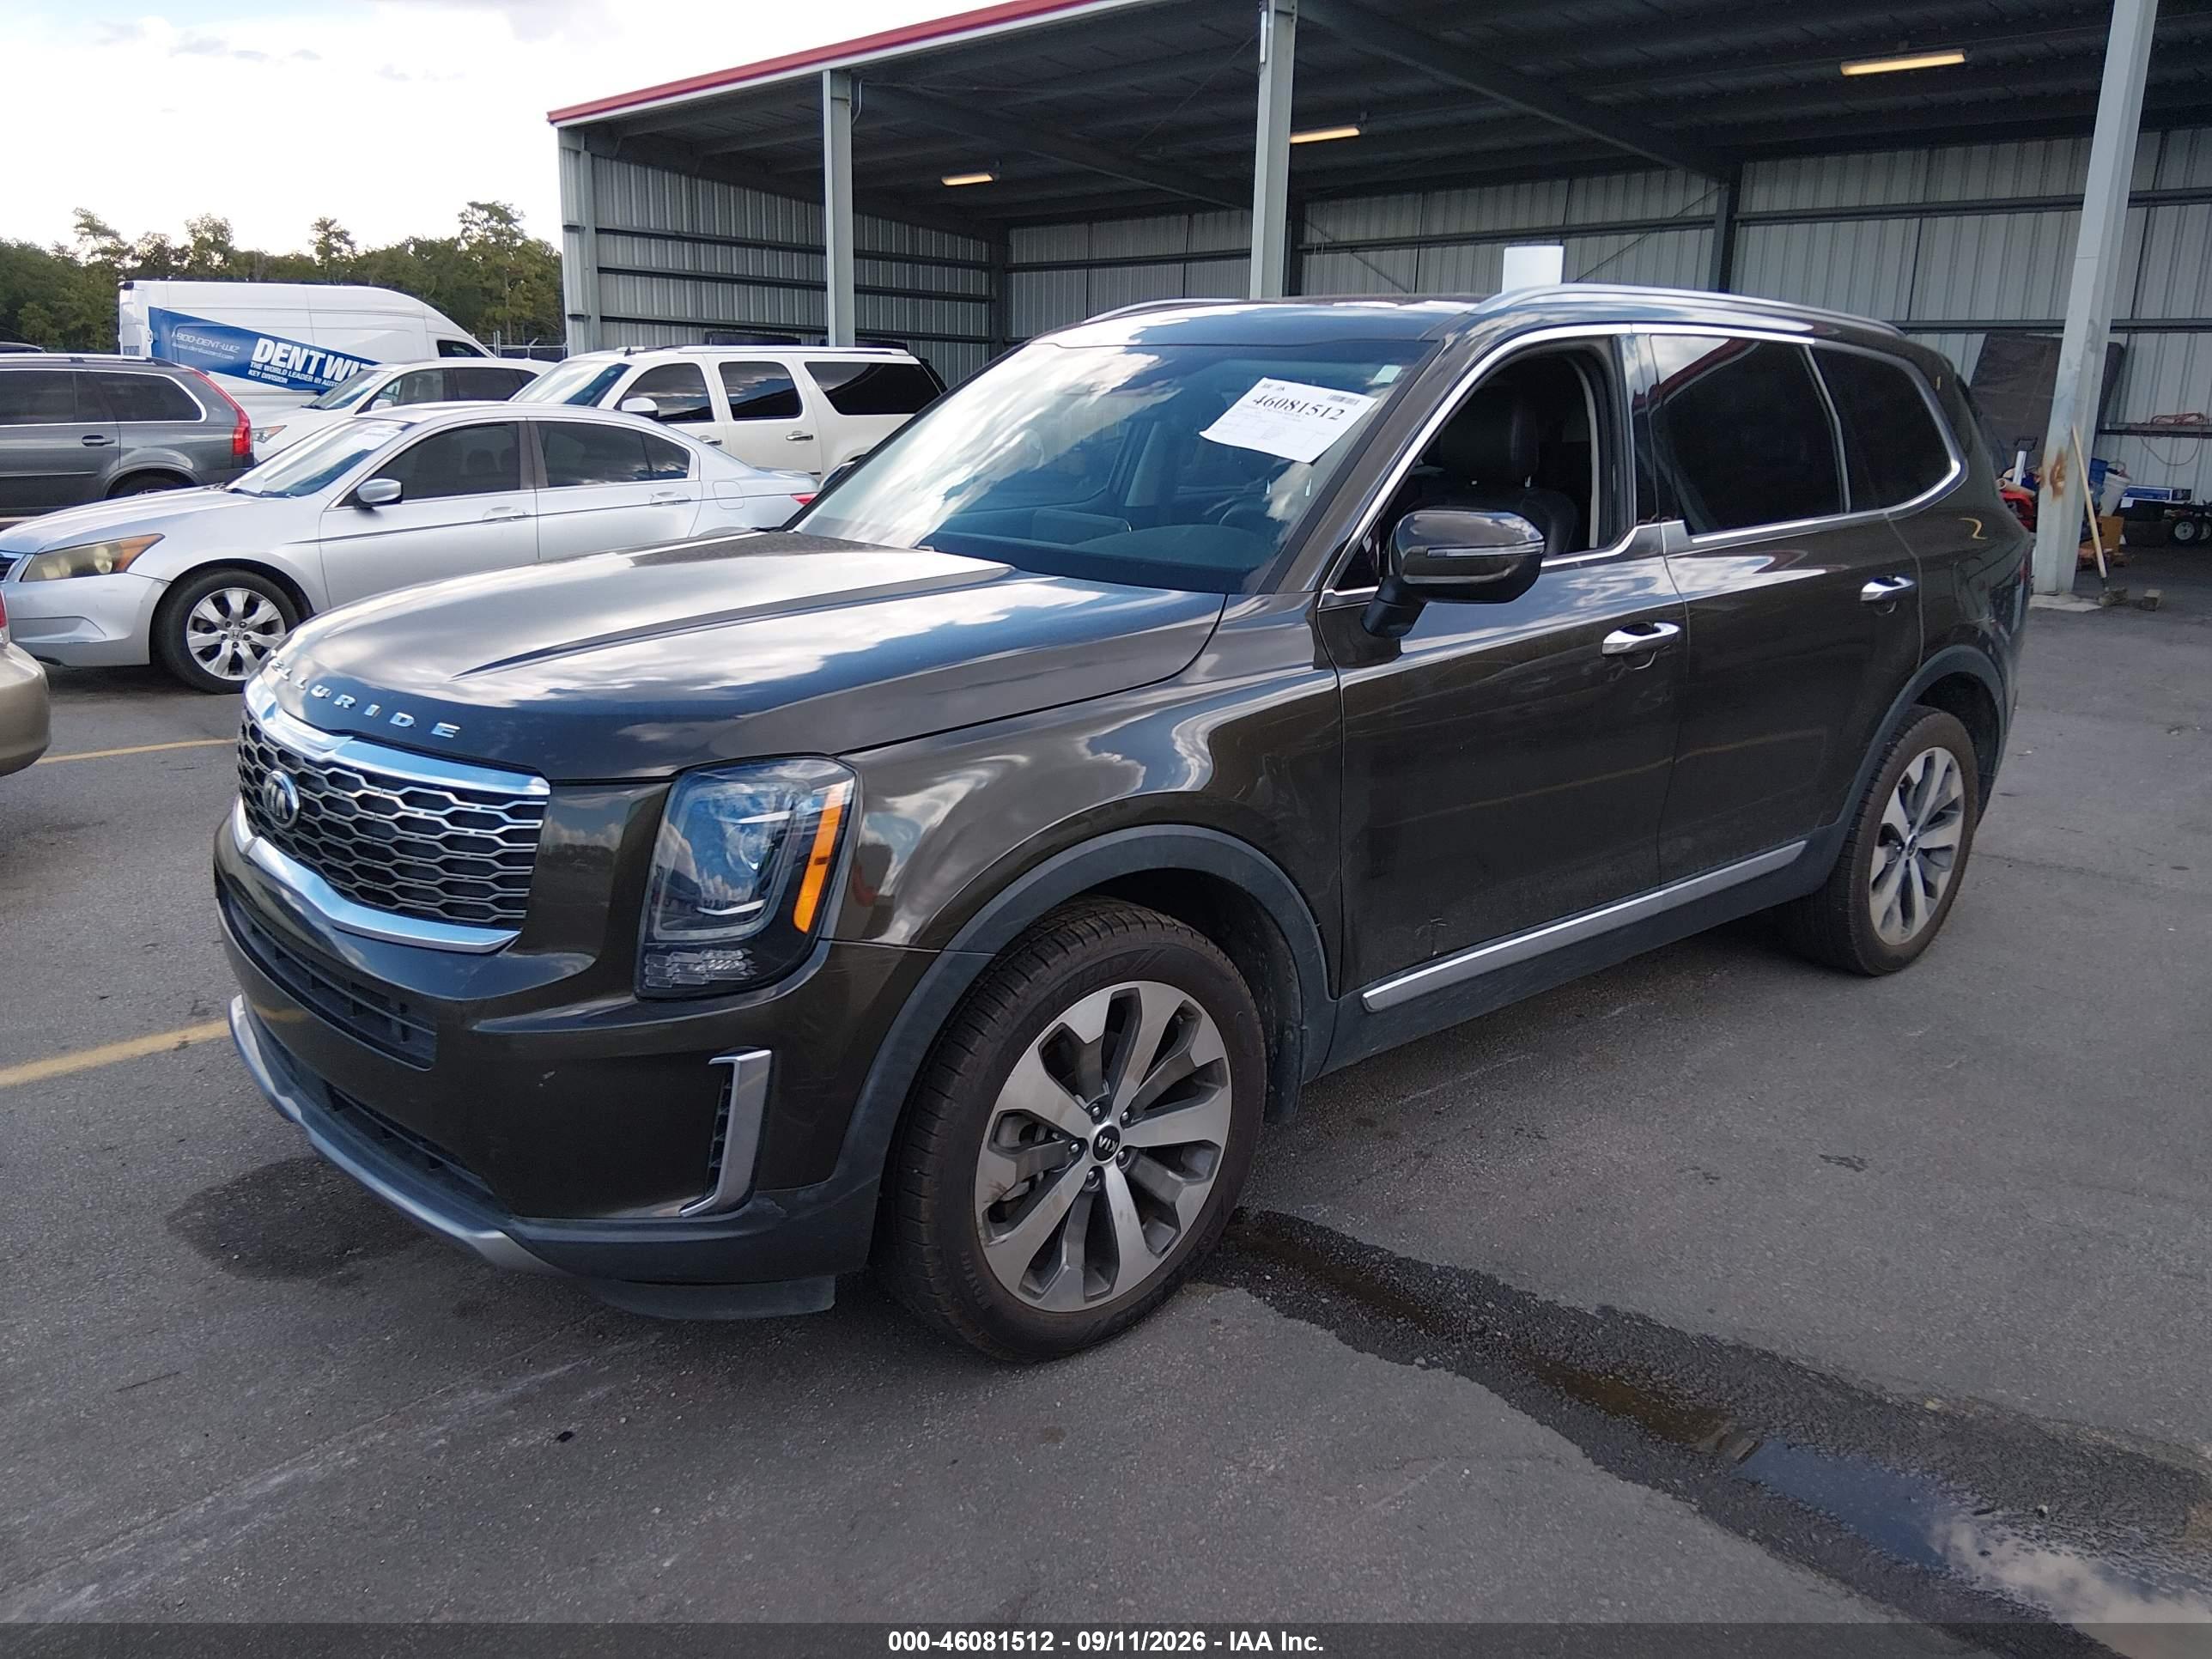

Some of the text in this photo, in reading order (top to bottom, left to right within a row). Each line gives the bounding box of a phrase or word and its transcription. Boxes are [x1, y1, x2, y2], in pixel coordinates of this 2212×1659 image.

[250, 362, 263, 371] THE
[263, 364, 288, 376] WORLD
[288, 370, 314, 384] LEADER
[260, 372, 289, 385] DIVISION
[323, 355, 374, 382] WI
[1253, 394, 1346, 421] 46081512
